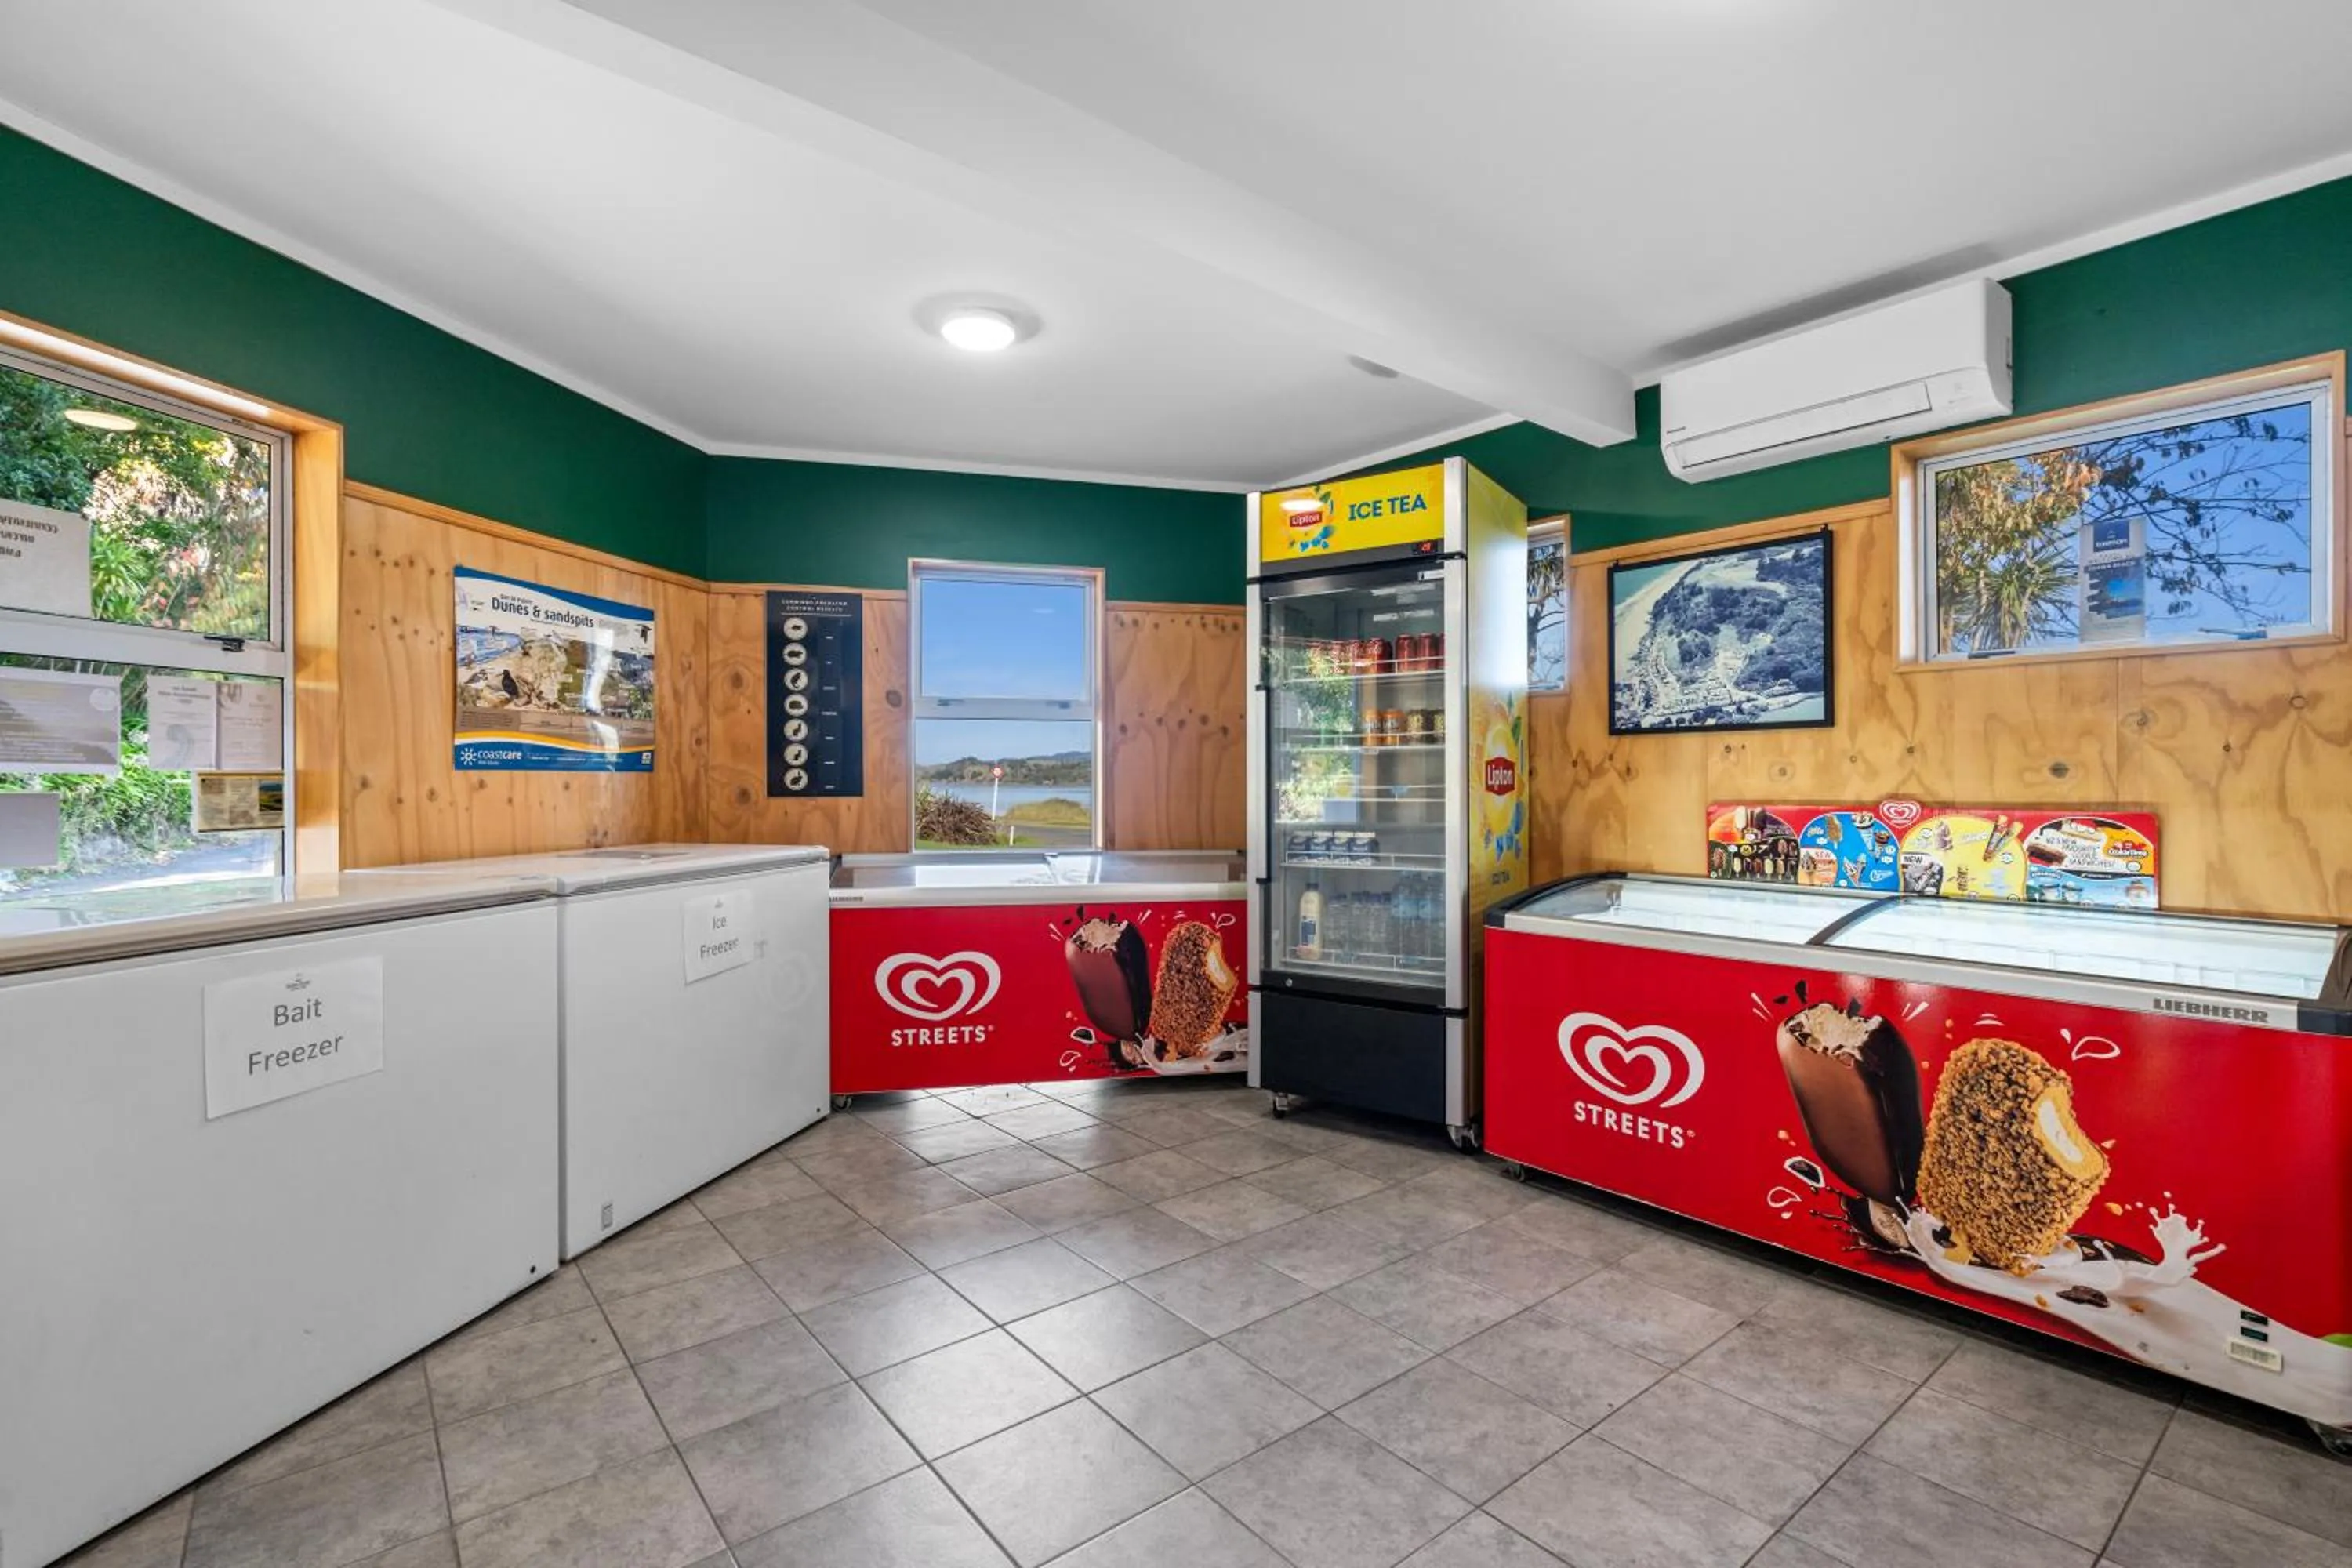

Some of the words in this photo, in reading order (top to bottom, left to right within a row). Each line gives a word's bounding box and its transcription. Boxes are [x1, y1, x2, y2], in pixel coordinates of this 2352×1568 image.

[1291, 514, 1320, 526] Lipton
[1348, 499, 1384, 521] ICE
[1387, 493, 1428, 515] TEA
[492, 596, 530, 617] Dunes
[532, 605, 541, 619] &
[543, 608, 594, 629] sandspits
[1486, 764, 1513, 791] Lipton
[713, 915, 727, 931] Ice
[700, 937, 739, 960] Freezer
[274, 998, 322, 1027] Bait
[2152, 998, 2269, 1023] LIEBHERR
[891, 1024, 986, 1047] STREETS
[248, 1035, 344, 1076] Freezer
[1573, 1100, 1686, 1149] STREETS
